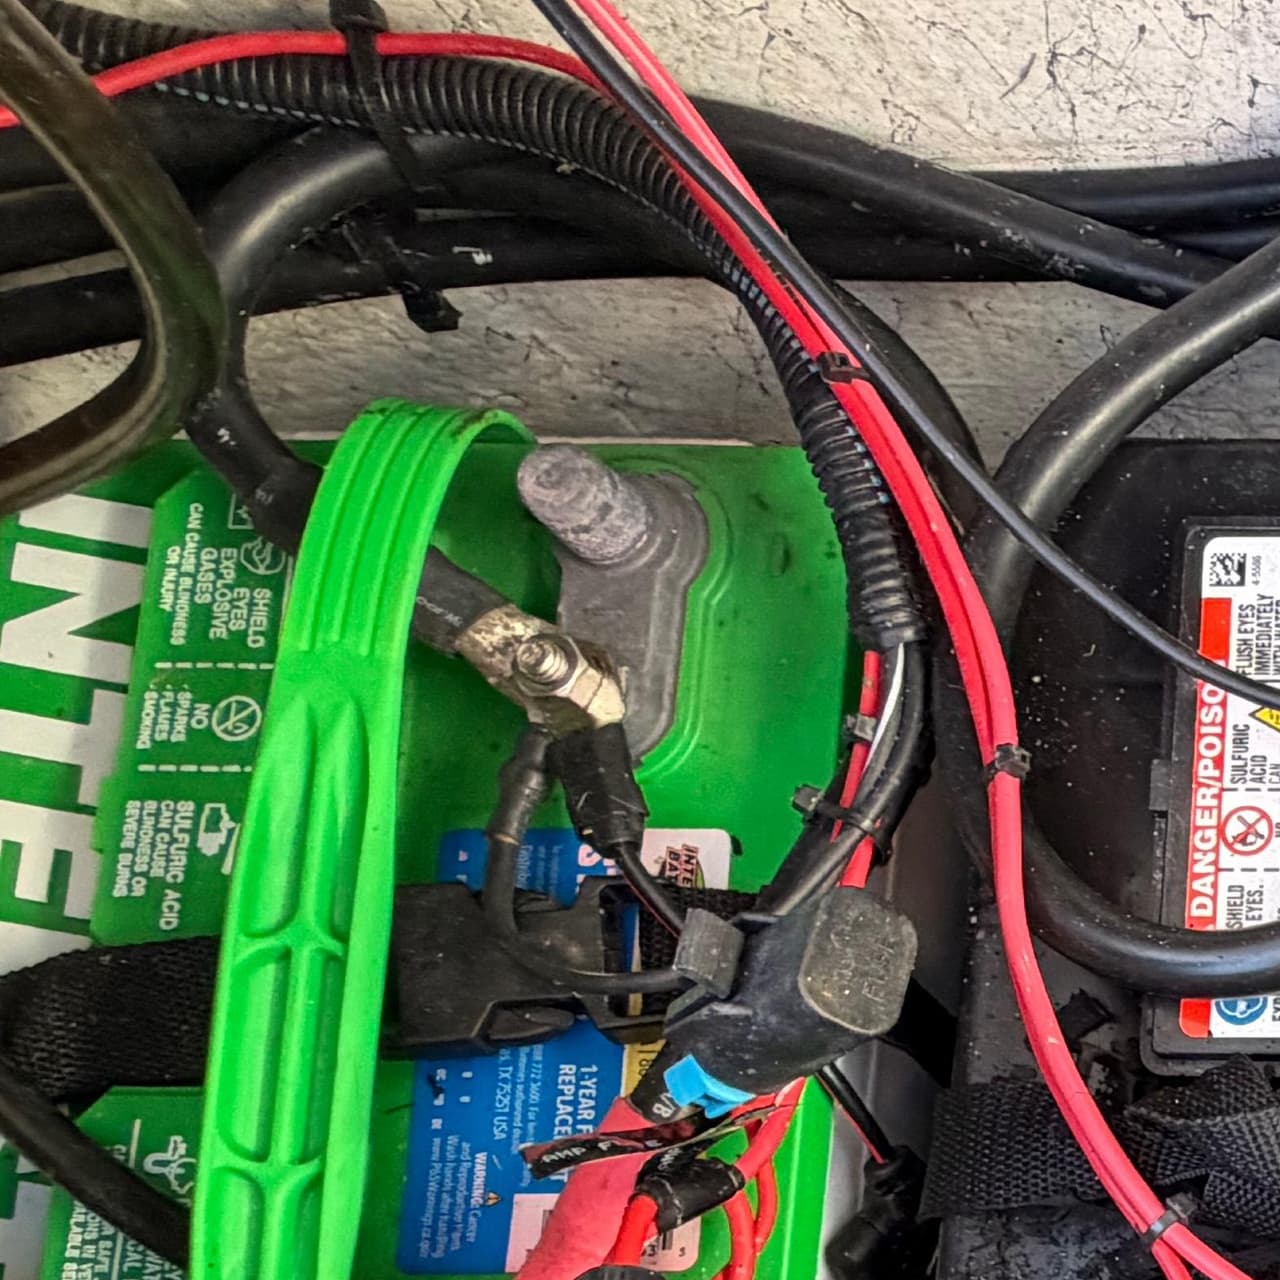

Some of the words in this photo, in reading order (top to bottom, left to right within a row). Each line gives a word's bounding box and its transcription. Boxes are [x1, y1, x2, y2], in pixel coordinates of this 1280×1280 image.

[193, 547, 216, 604] GASES
[208, 547, 237, 640] EXPLOSIVE
[228, 587, 248, 631] EYES
[246, 587, 271, 648] SHIELD
[1237, 603, 1256, 631] EYES
[1235, 634, 1254, 676] FLUSH
[1255, 593, 1274, 676] IMMEDIATELY
[190, 703, 210, 730] NO
[1231, 723, 1250, 785] SULFURIC
[1250, 754, 1267, 785] ACID
[1192, 659, 1227, 917] DANGER/POISO
[166, 799, 195, 883] SULFURIC
[159, 888, 181, 930] ACID
[1226, 884, 1245, 928] SHIELD
[1245, 883, 1265, 922] EYES.
[496, 1066, 512, 1080] TX
[577, 1064, 598, 1120] 1-YEAR
[494, 1082, 512, 1114] 75251
[493, 1117, 511, 1140] USA
